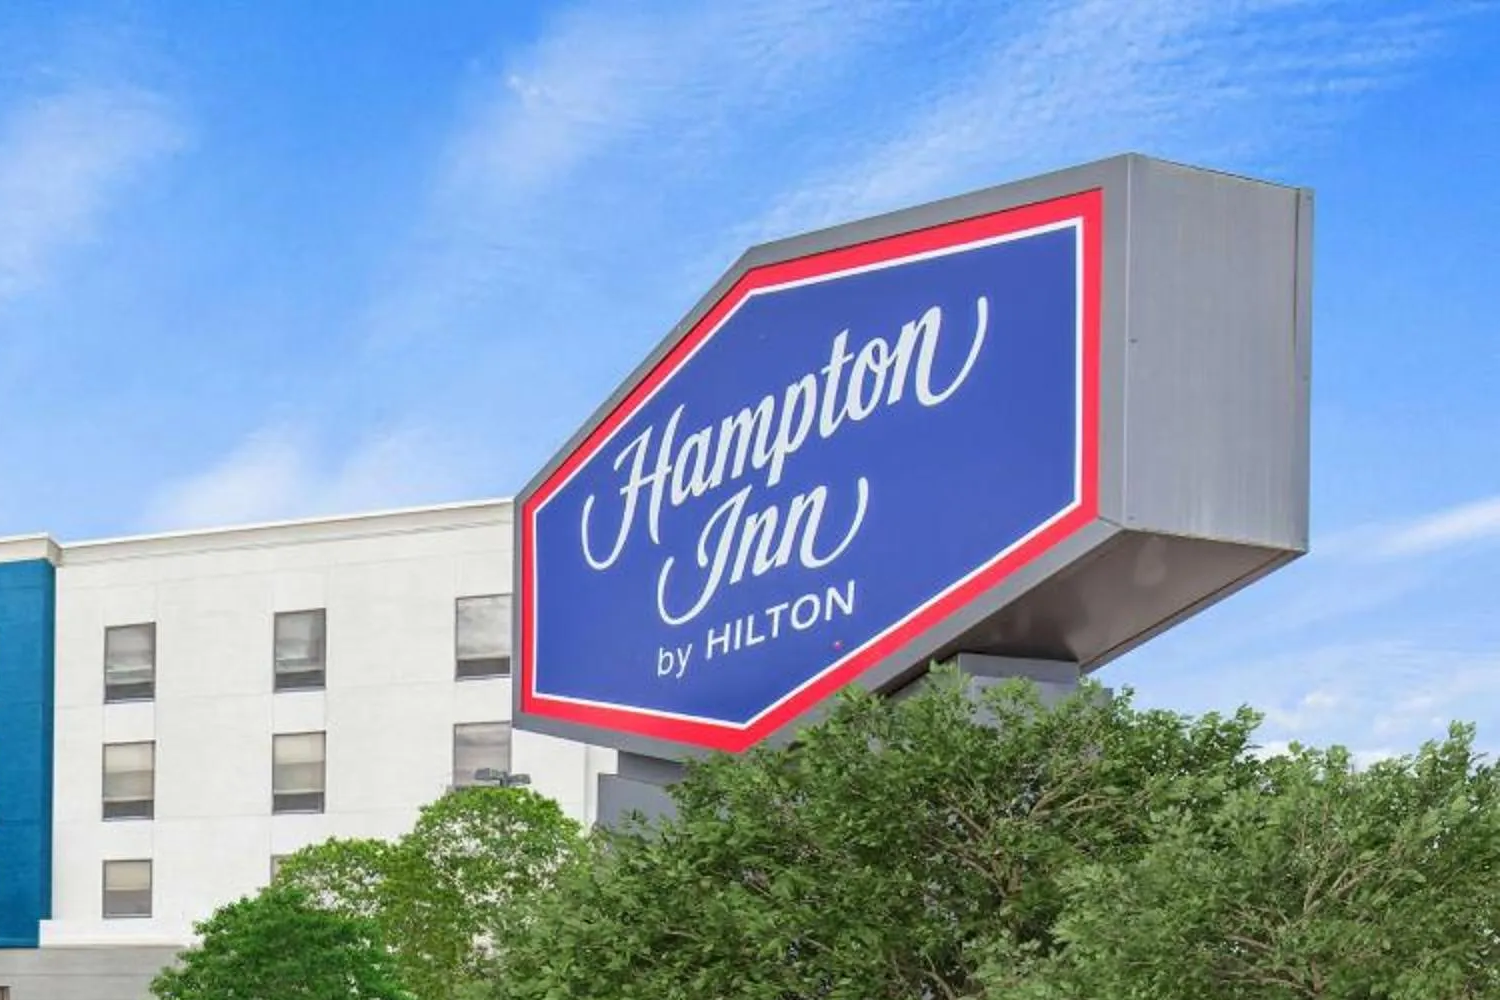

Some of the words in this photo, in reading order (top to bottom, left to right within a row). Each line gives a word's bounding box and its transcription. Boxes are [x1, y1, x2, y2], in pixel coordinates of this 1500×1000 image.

[581, 296, 989, 571] Hampton
[657, 476, 869, 627] Inn
[657, 643, 693, 680] by
[706, 579, 855, 660] HILTON
